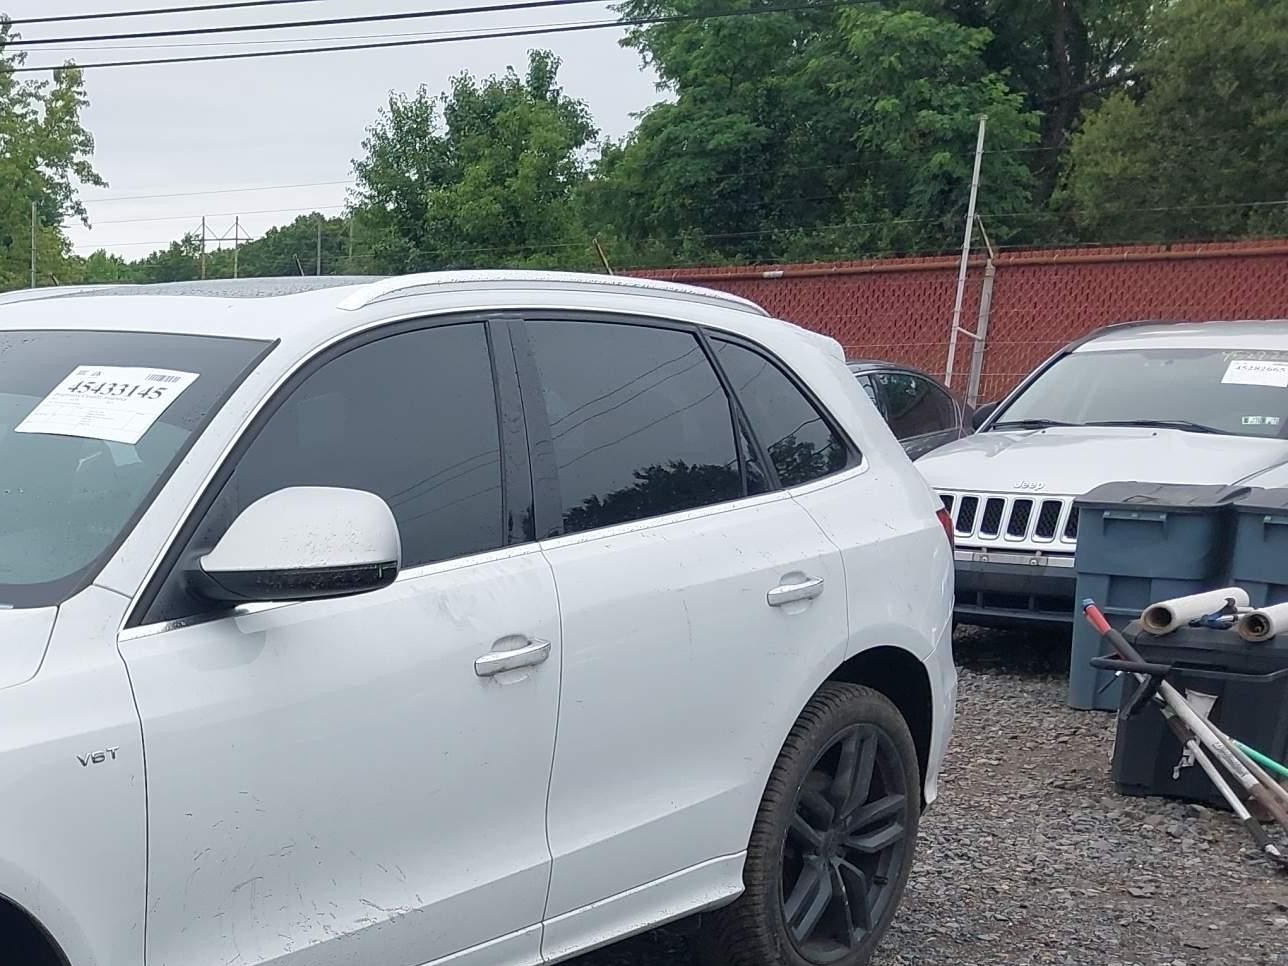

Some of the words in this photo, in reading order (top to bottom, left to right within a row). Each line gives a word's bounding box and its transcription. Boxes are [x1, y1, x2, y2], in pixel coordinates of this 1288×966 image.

[67, 379, 169, 400] 45433145
[1013, 479, 1045, 491] Jeep
[76, 746, 119, 767] V6T
